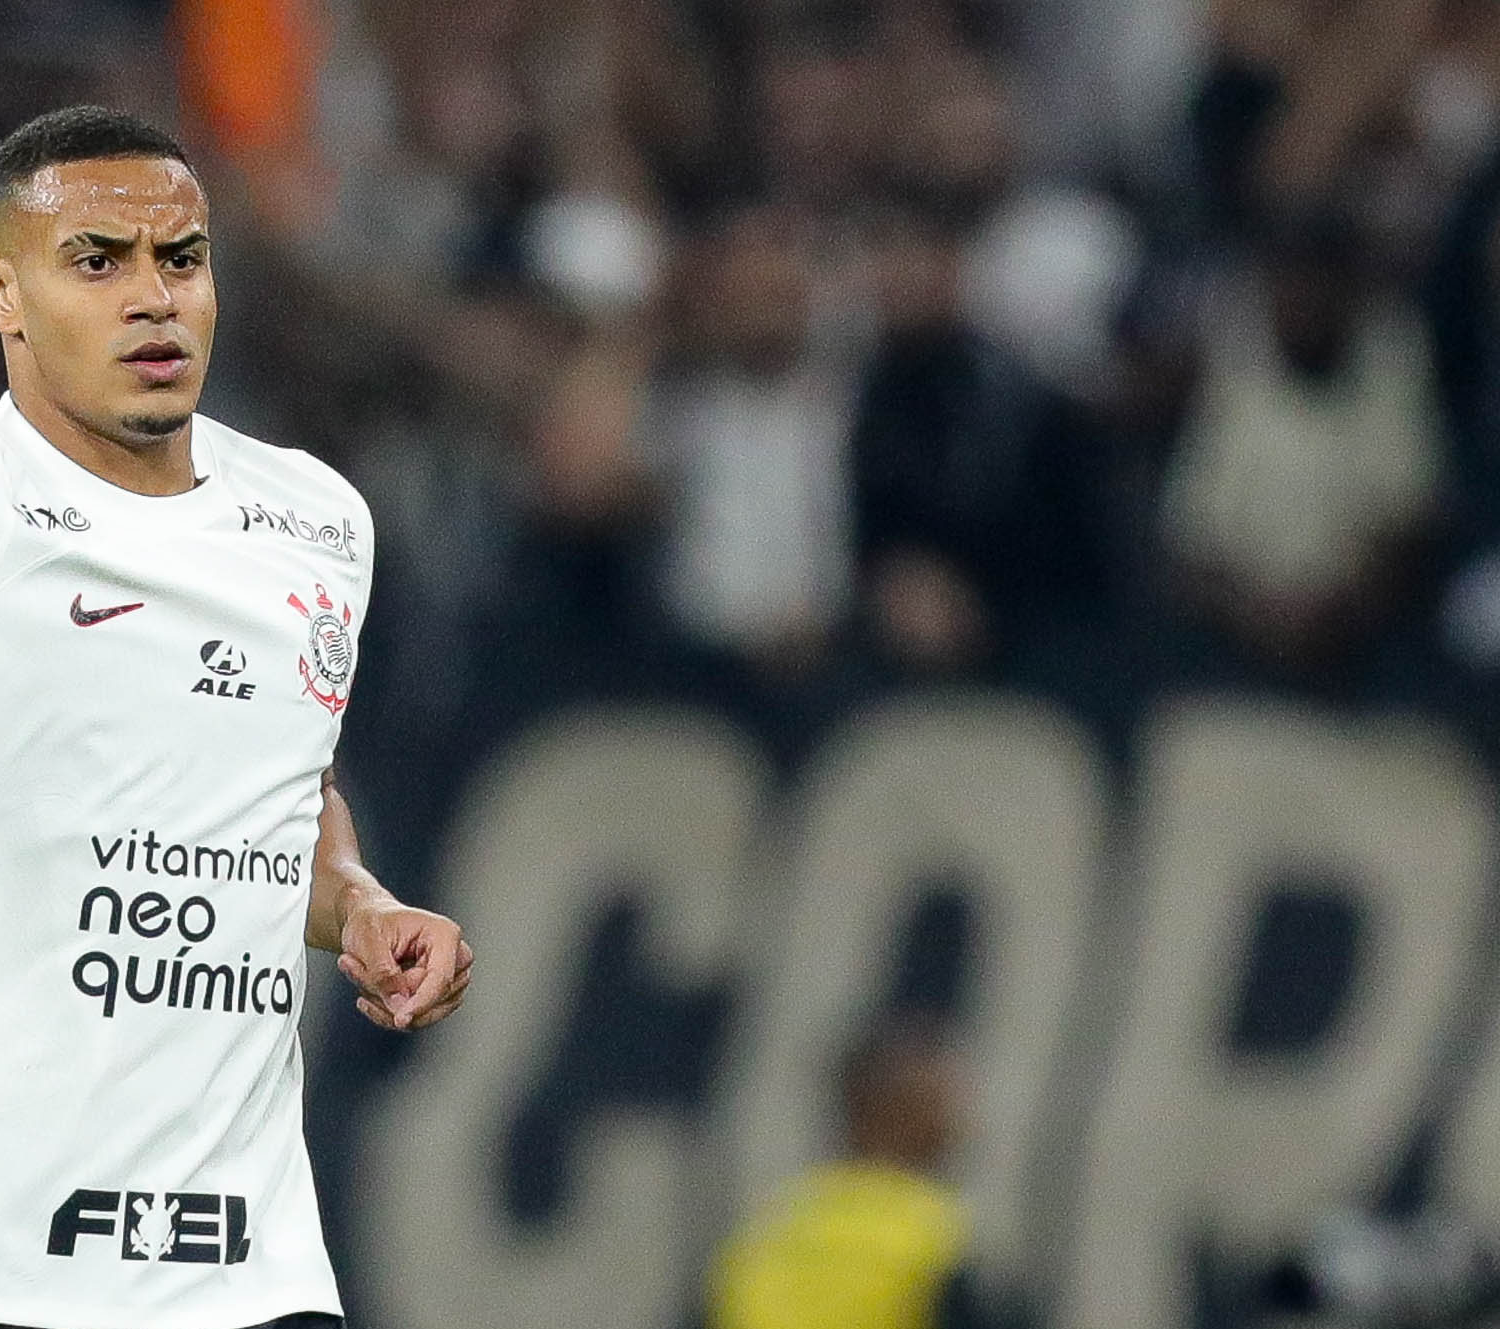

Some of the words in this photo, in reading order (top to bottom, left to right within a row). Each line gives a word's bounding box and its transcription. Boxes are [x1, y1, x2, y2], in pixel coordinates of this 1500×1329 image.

[237, 503, 357, 562] pixbet
[191, 677, 257, 700] ALE
[91, 828, 301, 887] vitaminas
[78, 886, 216, 943] neo
[72, 946, 293, 1018] química
